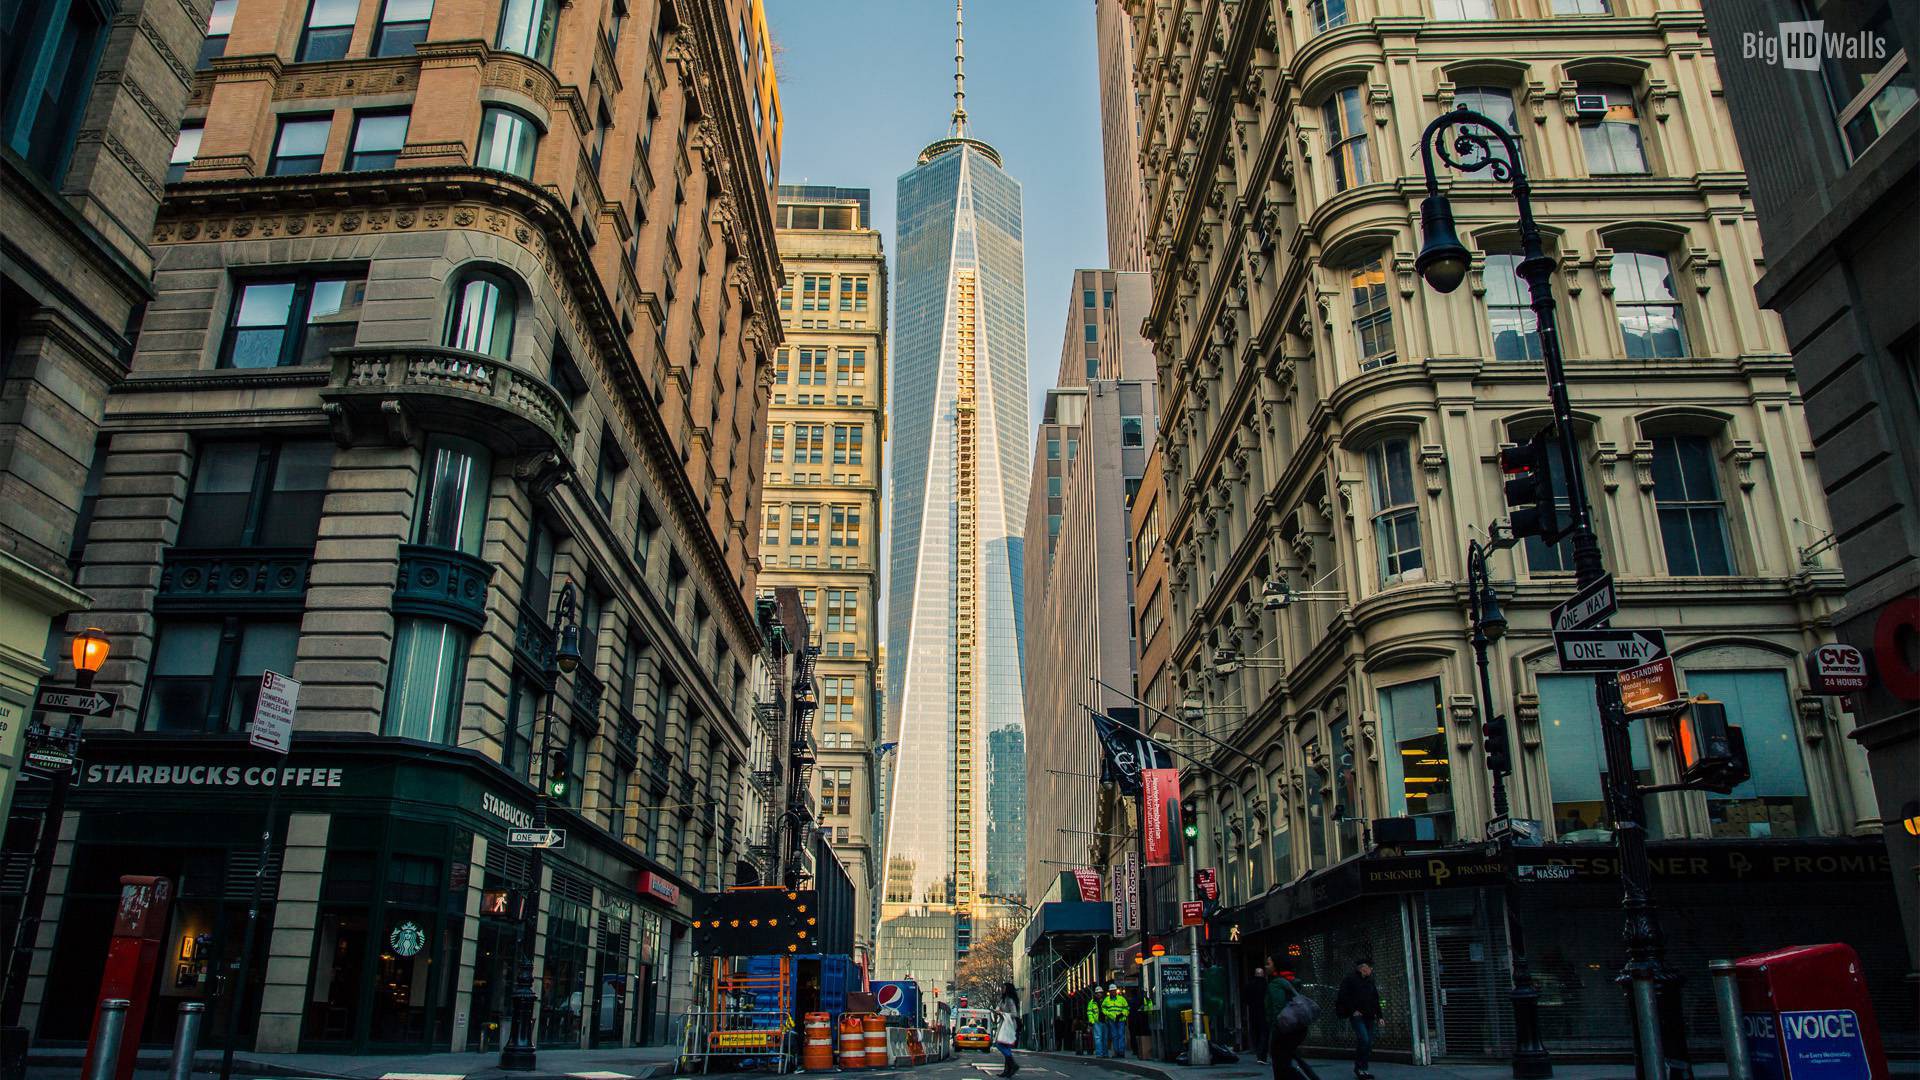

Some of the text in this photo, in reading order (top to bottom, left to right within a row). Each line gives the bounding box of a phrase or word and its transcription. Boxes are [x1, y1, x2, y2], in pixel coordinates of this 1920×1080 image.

[1561, 591, 1607, 630] ONE WAY
[1573, 642, 1649, 659] ONE WAY
[1819, 648, 1860, 665] CVS
[1621, 663, 1664, 682] NO STANDING
[1822, 664, 1861, 673] pharmacy
[264, 672, 273, 688] 3
[1622, 681, 1642, 690] Monday
[1645, 675, 1662, 685] Friday
[1824, 678, 1863, 686] 24 HOURS
[47, 694, 103, 709] ONE WAY
[262, 691, 290, 706] COMMERCIAL
[261, 700, 292, 715] VEHICLES ONLY
[87, 764, 343, 787] STARBUCKS COFFEE
[482, 792, 530, 829] STARBUCKS
[516, 833, 556, 842] ONE WAY
[1369, 869, 1422, 881] DESIGNER
[1536, 869, 1569, 879] NASSAU
[1114, 866, 1122, 904] Roberts
[1128, 852, 1137, 928] Lucille Roberts
[1744, 1015, 1775, 1039] OICE
[1788, 1014, 1856, 1040] VOICE
